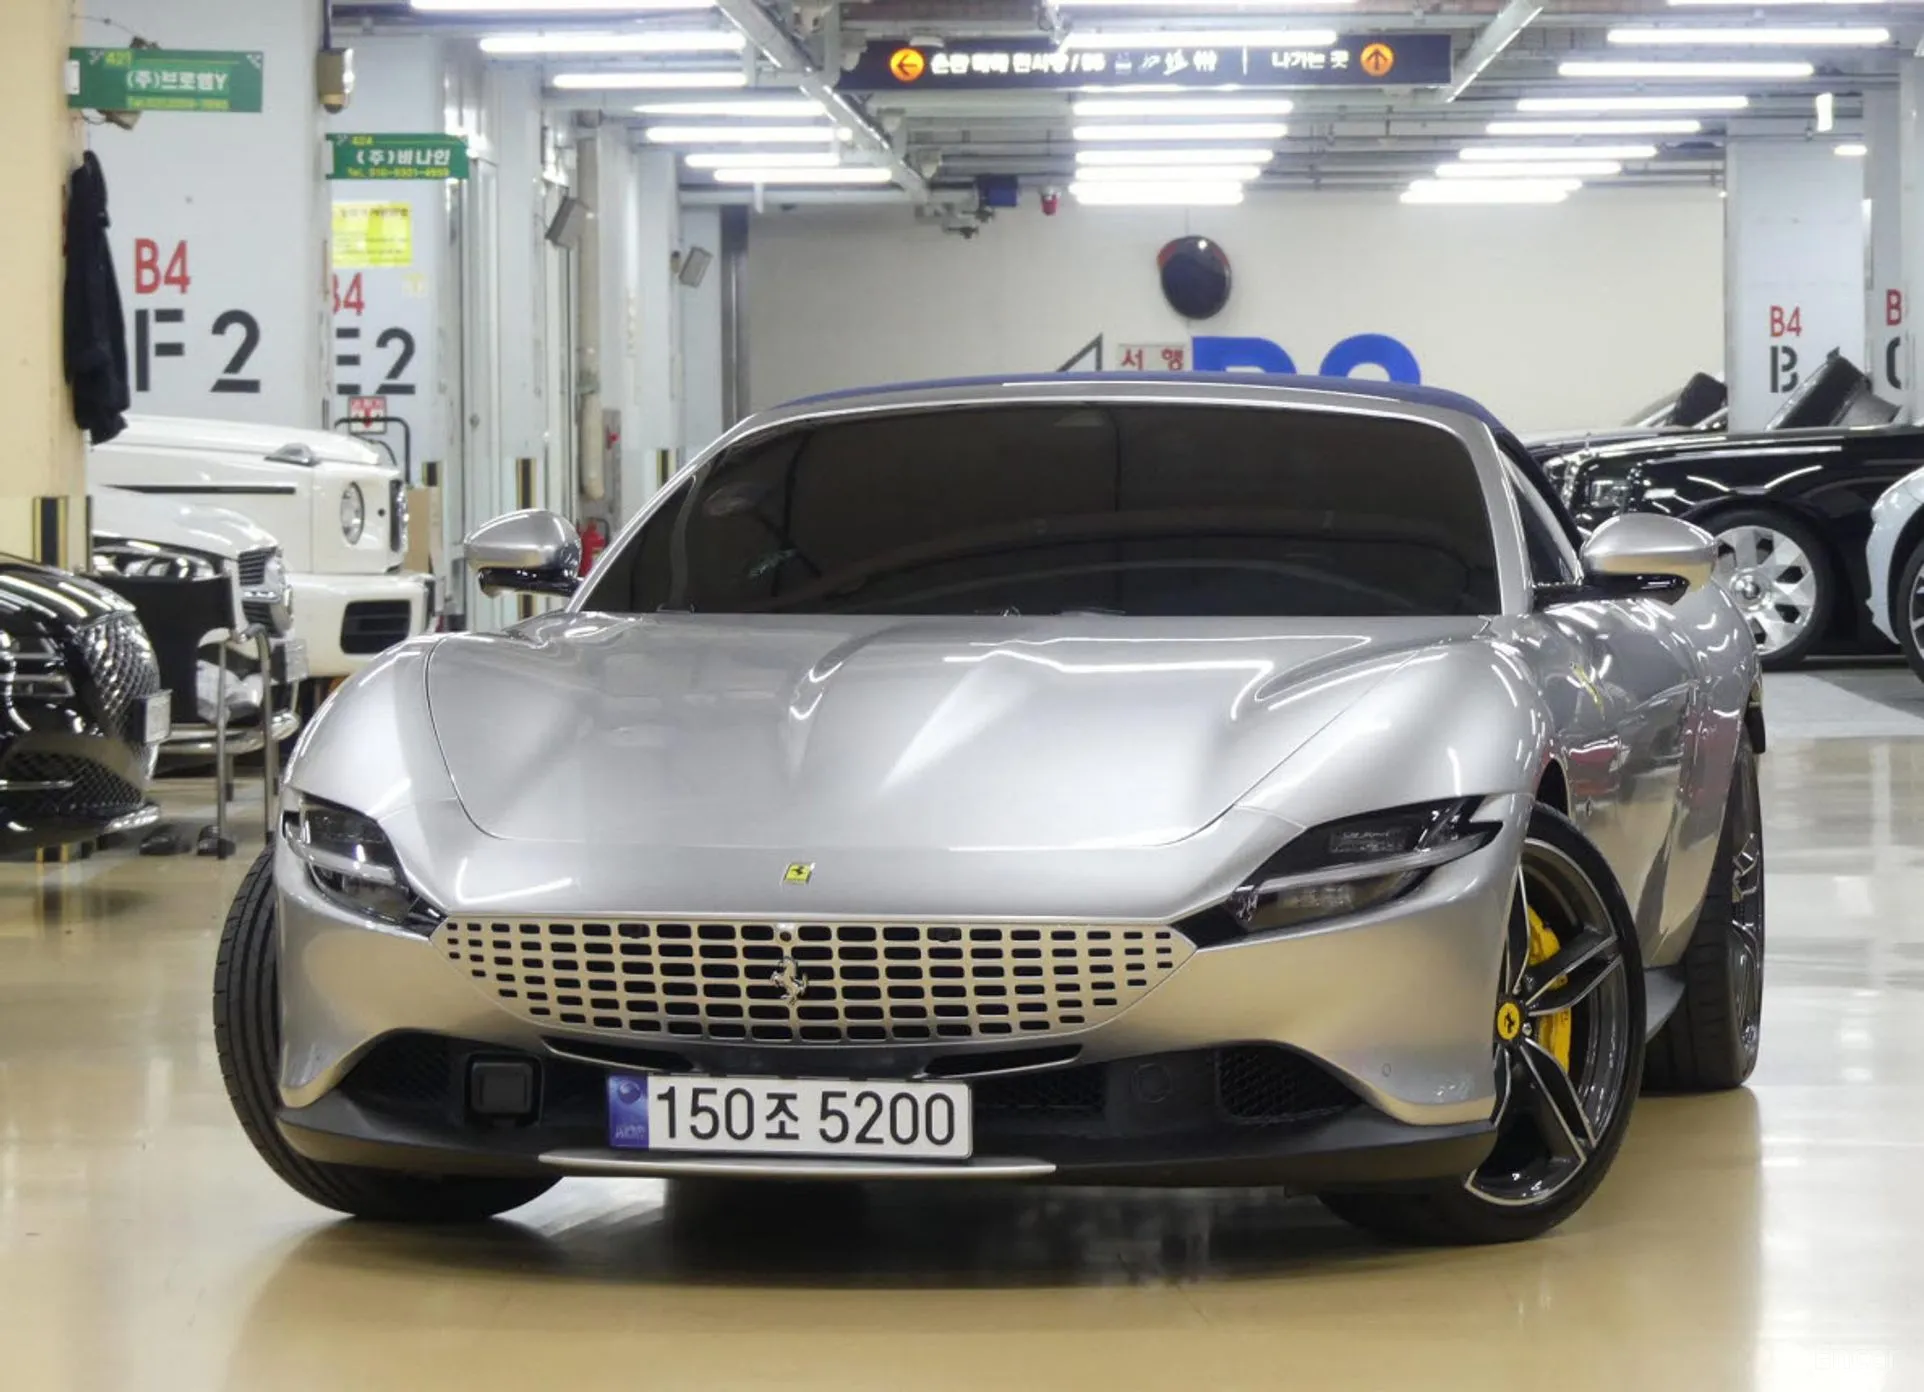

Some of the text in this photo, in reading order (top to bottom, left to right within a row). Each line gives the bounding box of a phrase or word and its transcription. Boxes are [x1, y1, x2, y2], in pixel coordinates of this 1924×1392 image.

[1271, 50, 1349, 69] 나가는 곳
[135, 238, 191, 295] B4
[1769, 305, 1803, 337] B4
[1770, 345, 1799, 393] B
[656, 1086, 956, 1147] 150조 5200
